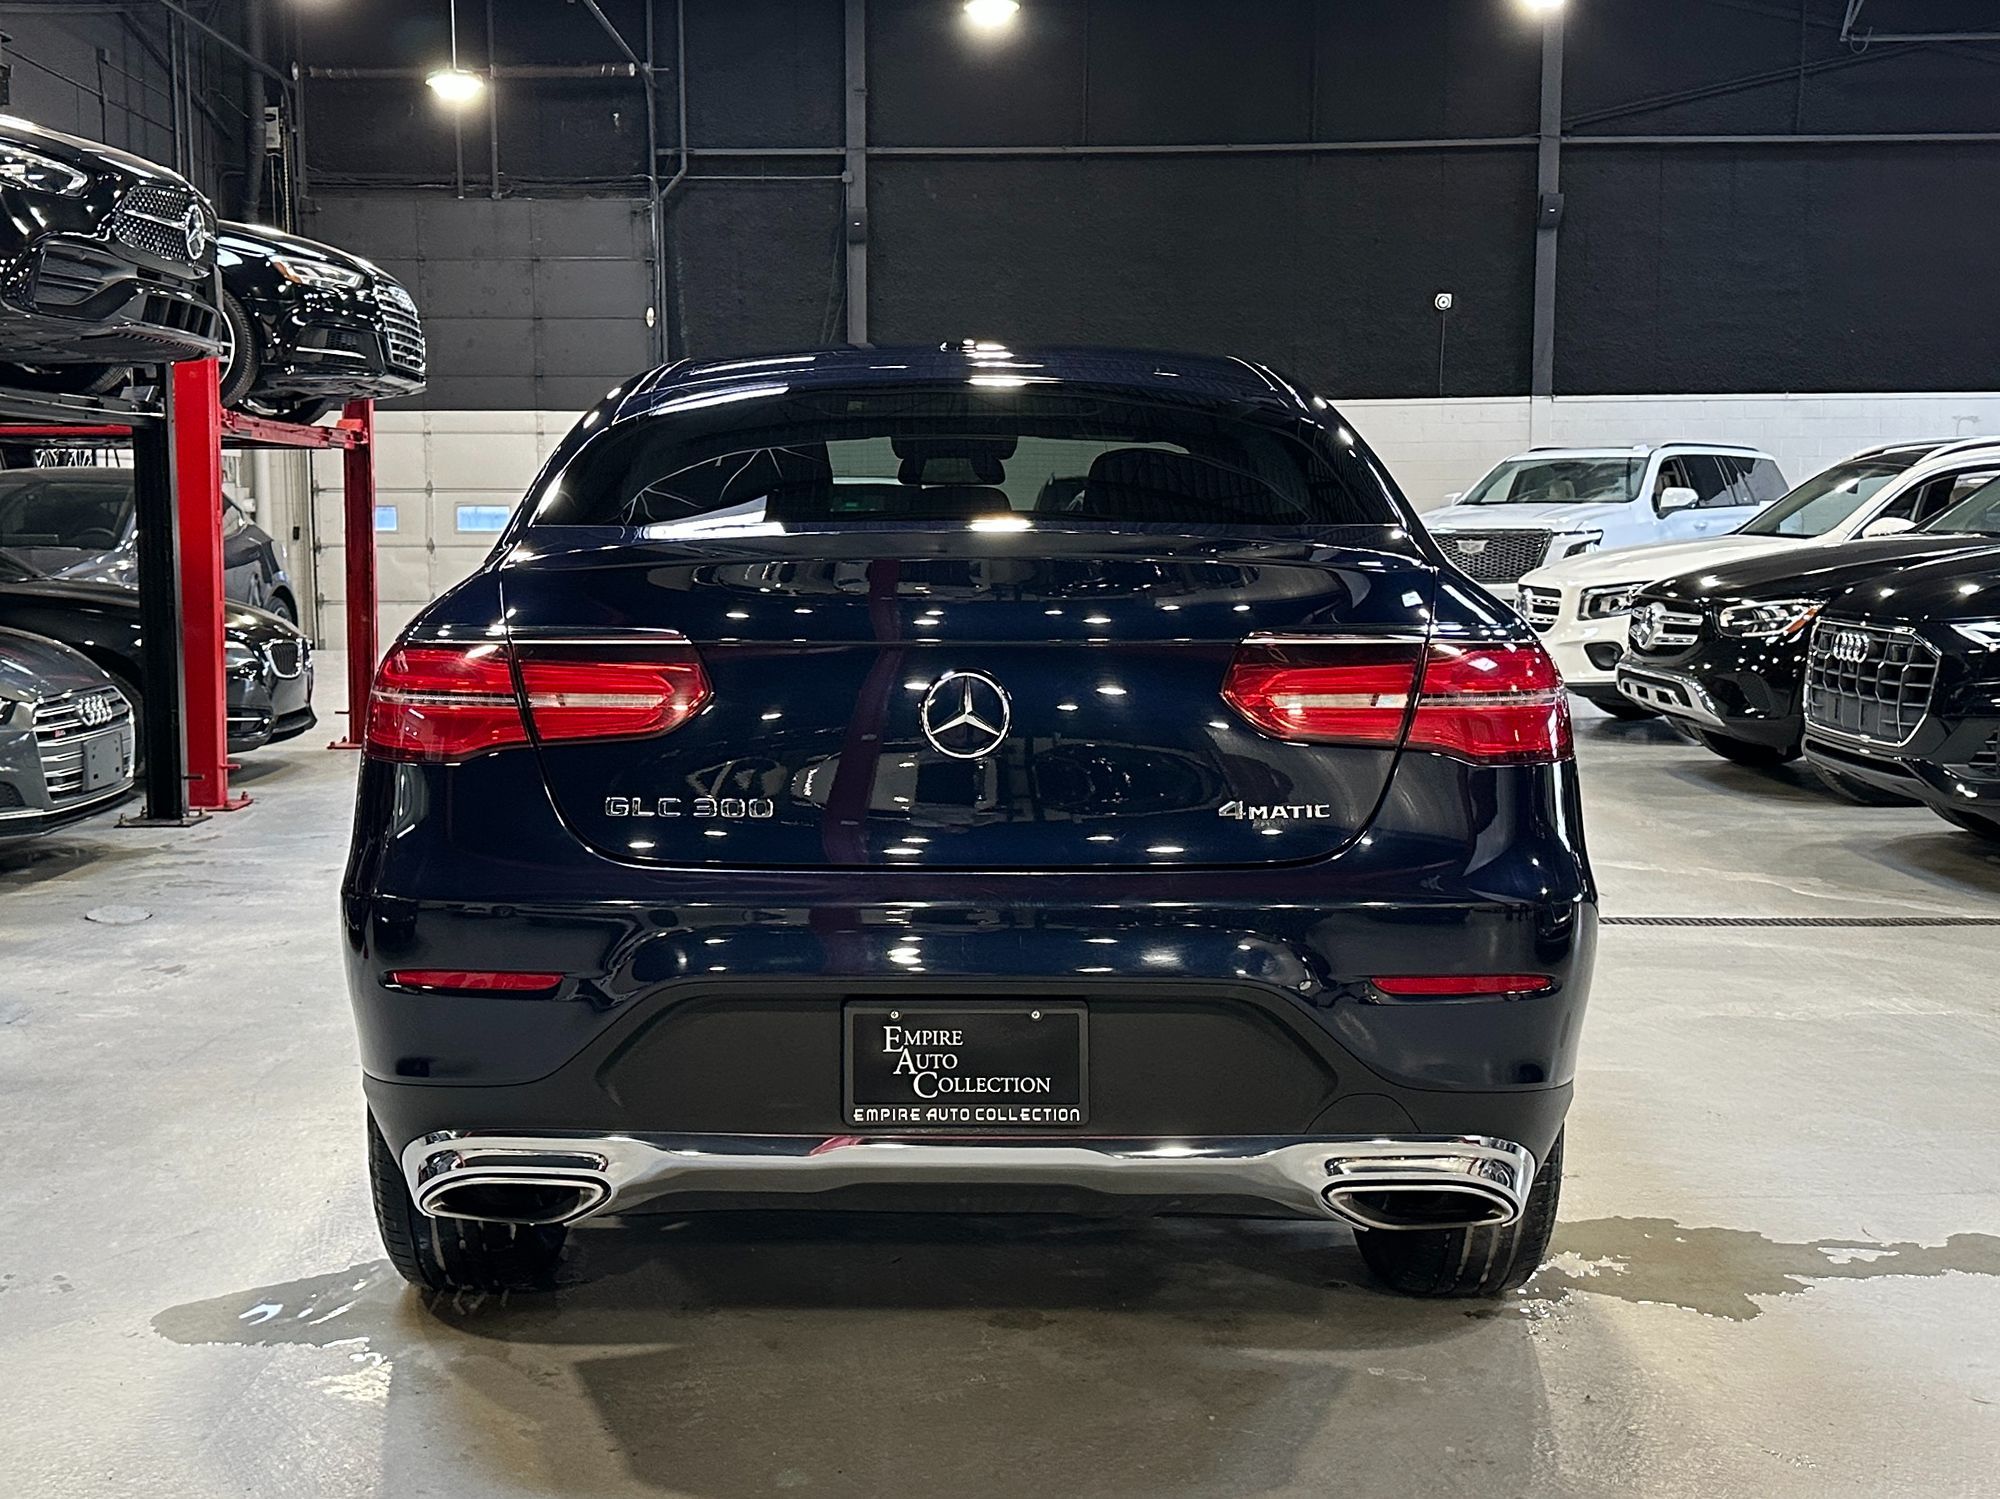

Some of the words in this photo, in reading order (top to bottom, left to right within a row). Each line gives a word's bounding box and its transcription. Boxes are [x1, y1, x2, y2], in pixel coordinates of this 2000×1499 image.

[605, 797, 681, 817] GLC
[693, 797, 774, 818] 300
[1218, 800, 1331, 820] 4MATIC
[882, 1025, 964, 1053] EMPIRE
[893, 1048, 958, 1075] AUTO
[913, 1071, 1051, 1099] COLLECTION
[853, 1108, 921, 1122] EMPIRE
[926, 1108, 969, 1122] AUTO
[975, 1108, 1080, 1122] COLLECTION
